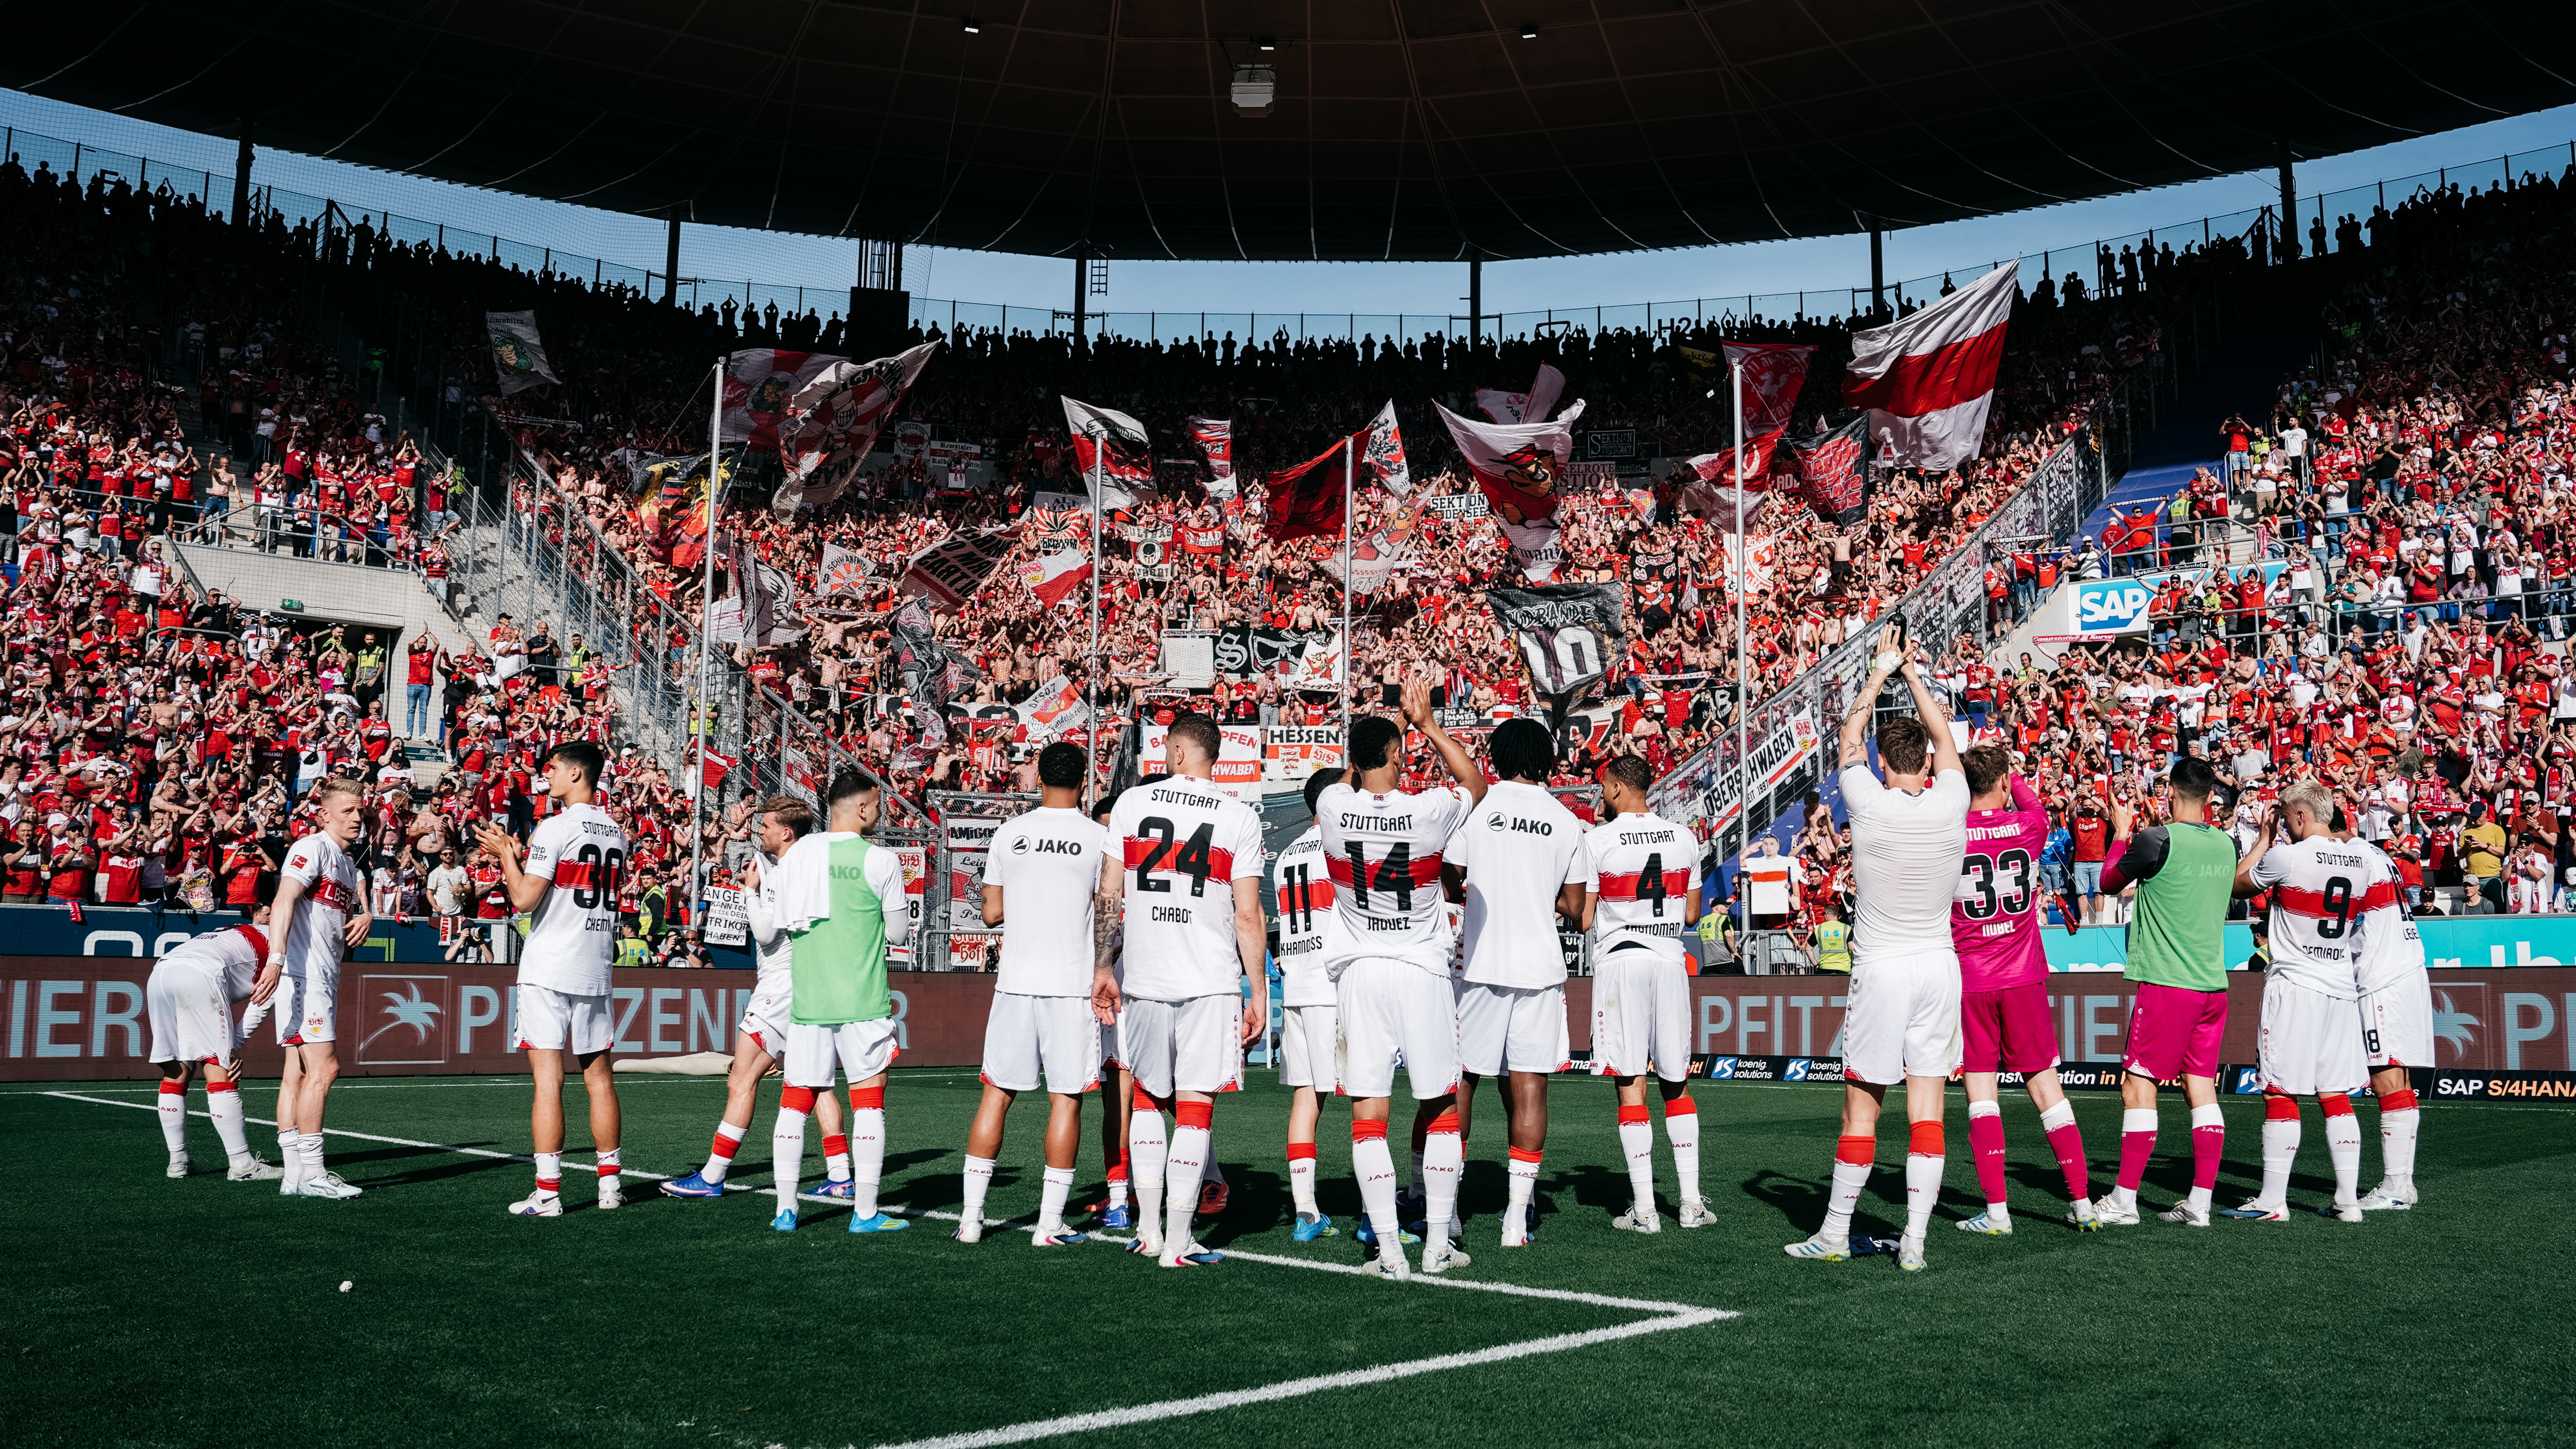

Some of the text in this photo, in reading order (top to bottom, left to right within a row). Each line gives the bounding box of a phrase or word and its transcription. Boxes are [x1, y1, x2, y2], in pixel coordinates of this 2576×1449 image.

[1432, 495, 1484, 509] SEKTON
[1201, 531, 1222, 541] BAD
[2081, 588, 2147, 622] SAP
[1270, 729, 1339, 744] HESSEN
[1747, 779, 1769, 803] EIT 1997
[1151, 789, 1222, 810] STUTTGART
[1340, 813, 1413, 832] STUTTGART
[1511, 817, 1553, 837] JAKO
[1619, 830, 1676, 846] STUTTGART
[1035, 839, 1082, 856] JAKO
[1137, 816, 1215, 898] 24
[2316, 852, 2364, 869] STUTTGART
[573, 843, 623, 912] 30
[829, 865, 861, 880] AKO
[1344, 840, 1415, 911] 14
[2199, 863, 2231, 878] JAKO
[1636, 853, 1667, 917] 4
[1960, 847, 2032, 921] 33
[702, 887, 746, 904] ANGE
[1284, 863, 1311, 935] 11
[711, 901, 732, 910] KANN
[2317, 876, 2352, 939] 9
[1152, 906, 1192, 924] CHABOT
[709, 916, 749, 931] TRIKOT
[1367, 917, 1411, 931] JAQUEZ
[706, 930, 745, 943] HABEN?
[1737, 1059, 1767, 1071] koenig
[1811, 1060, 1841, 1072] koenig
[1734, 1069, 1773, 1079] solutions
[2100, 1071, 2116, 1085] in
[2438, 1079, 2483, 1095] SAP
[1169, 1158, 1198, 1167] JAKO
[1367, 1172, 1395, 1181] JAKO
